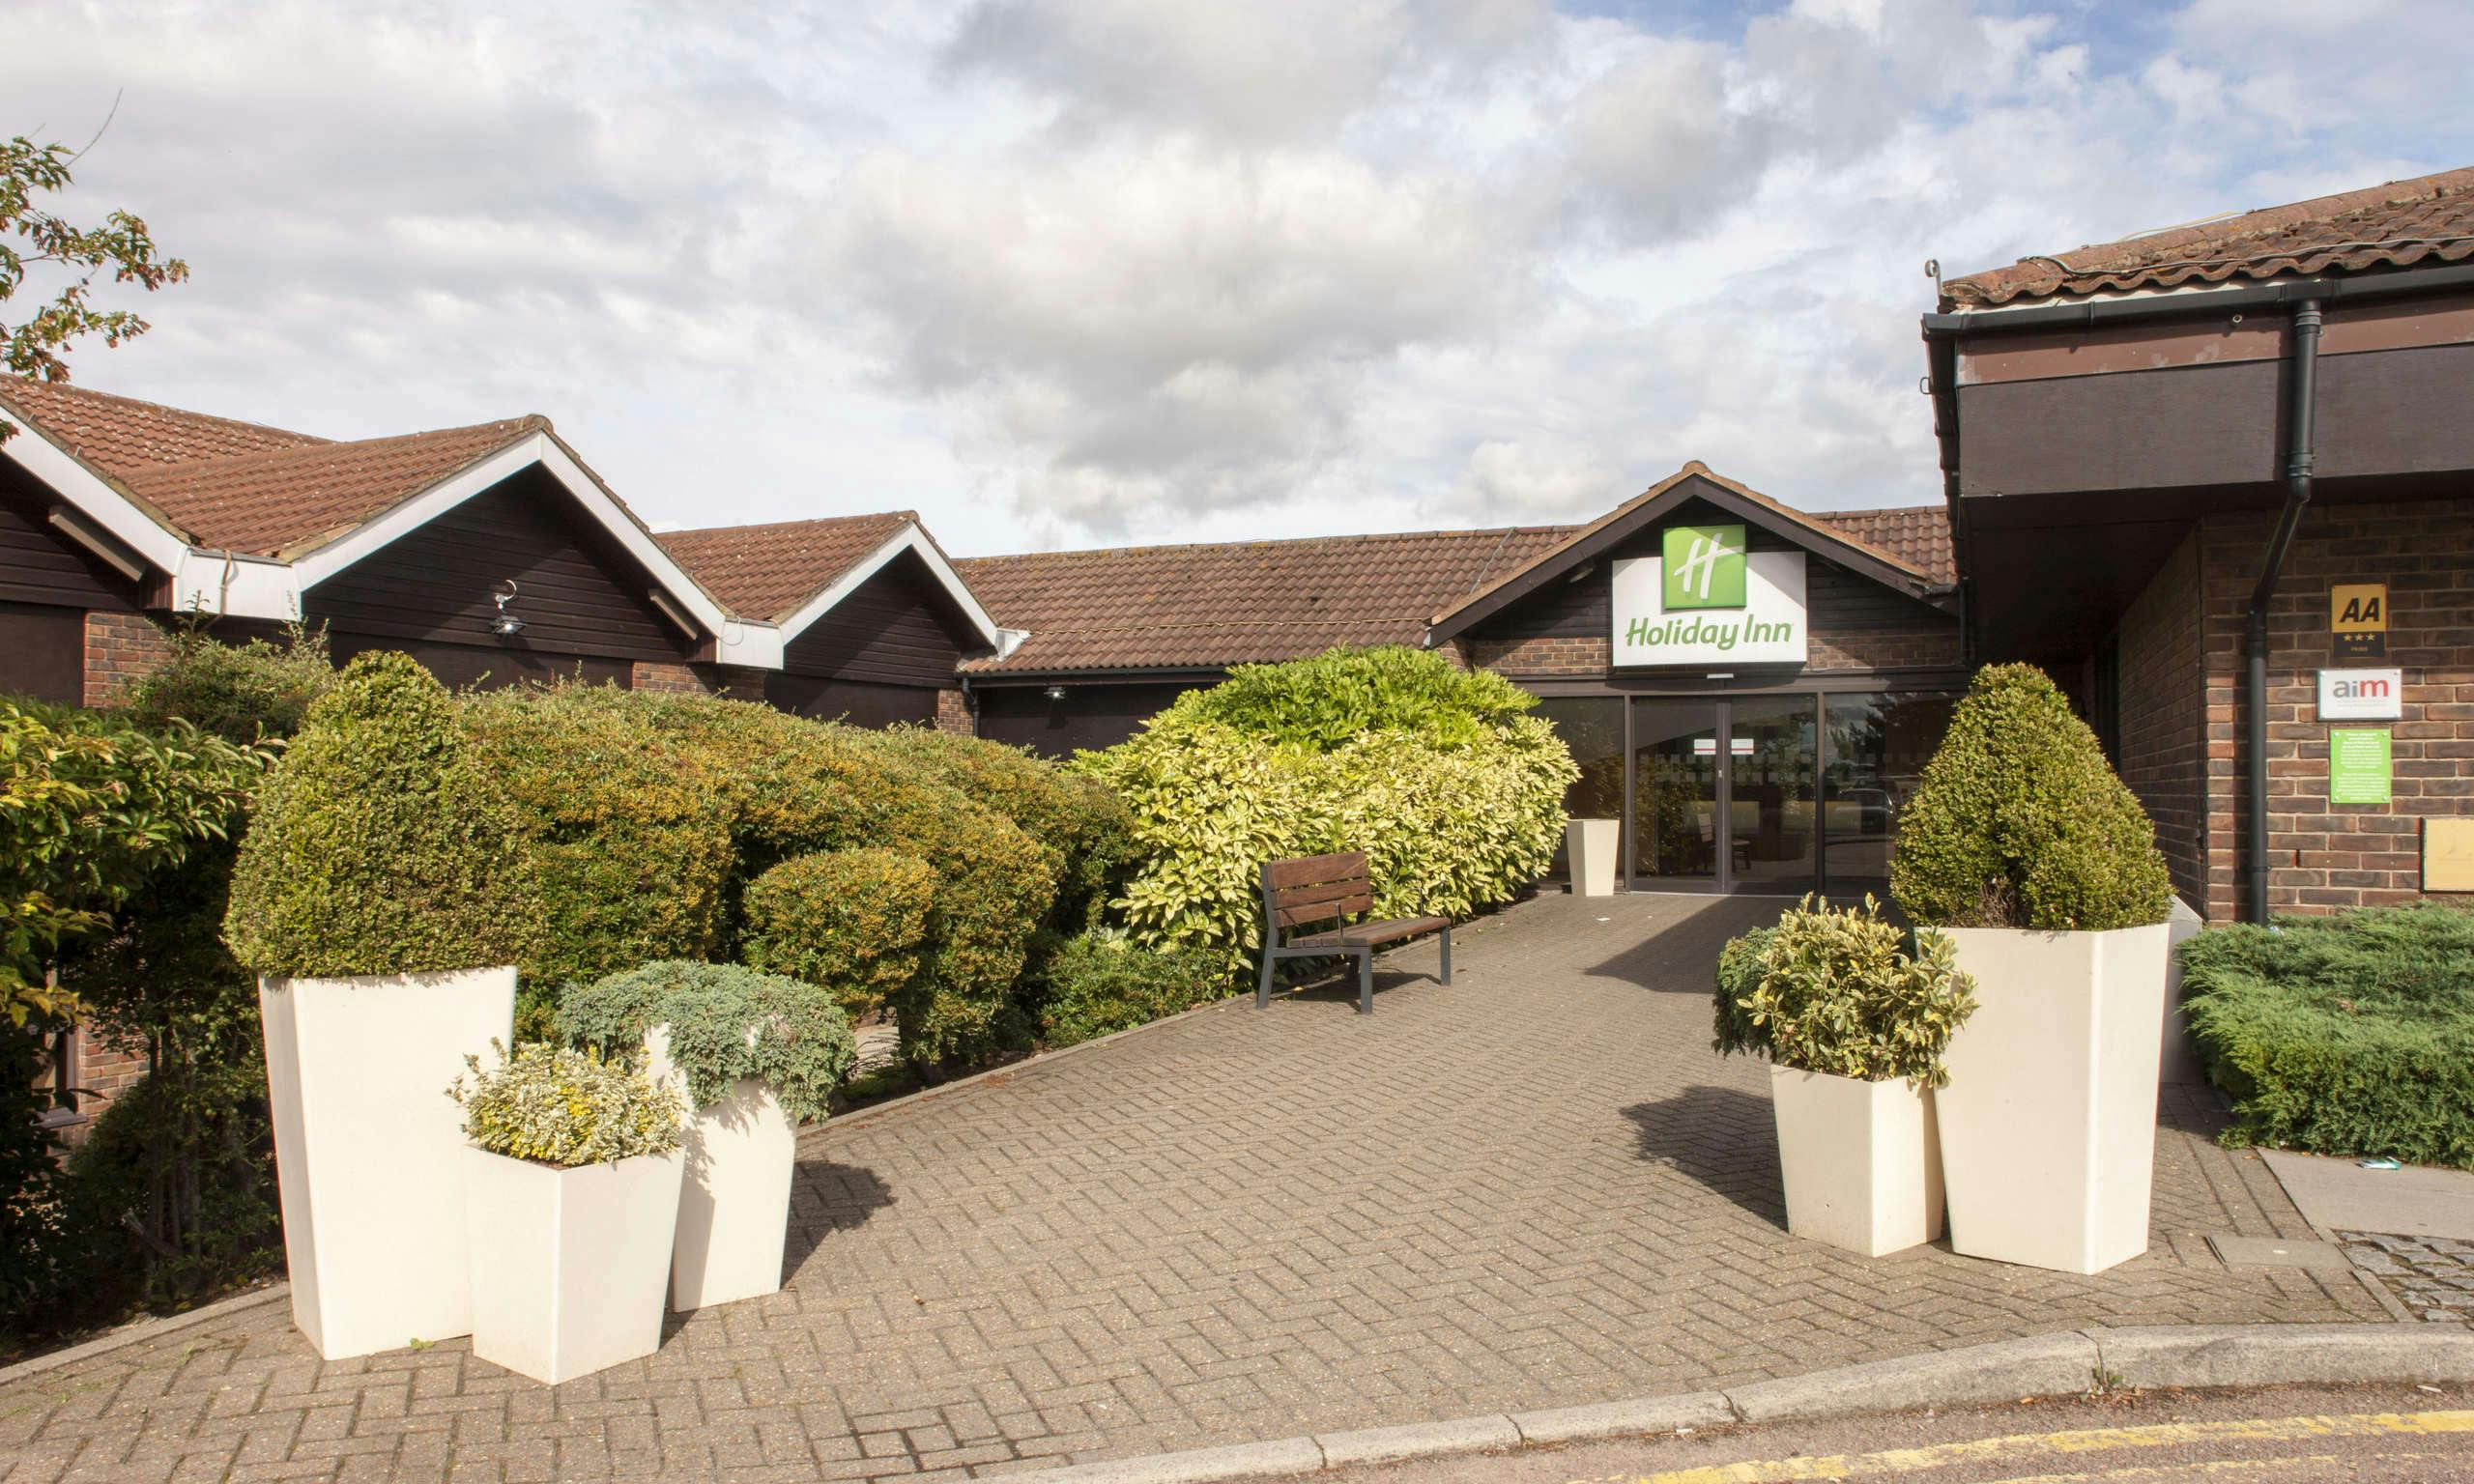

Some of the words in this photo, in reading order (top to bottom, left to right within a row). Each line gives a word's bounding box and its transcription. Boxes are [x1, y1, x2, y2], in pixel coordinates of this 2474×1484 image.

[1674, 532, 1743, 599] H
[2339, 597, 2379, 622] AA
[1625, 616, 1740, 650] Holiday
[1743, 614, 1793, 642] Inn
[2333, 680, 2389, 698] aim
